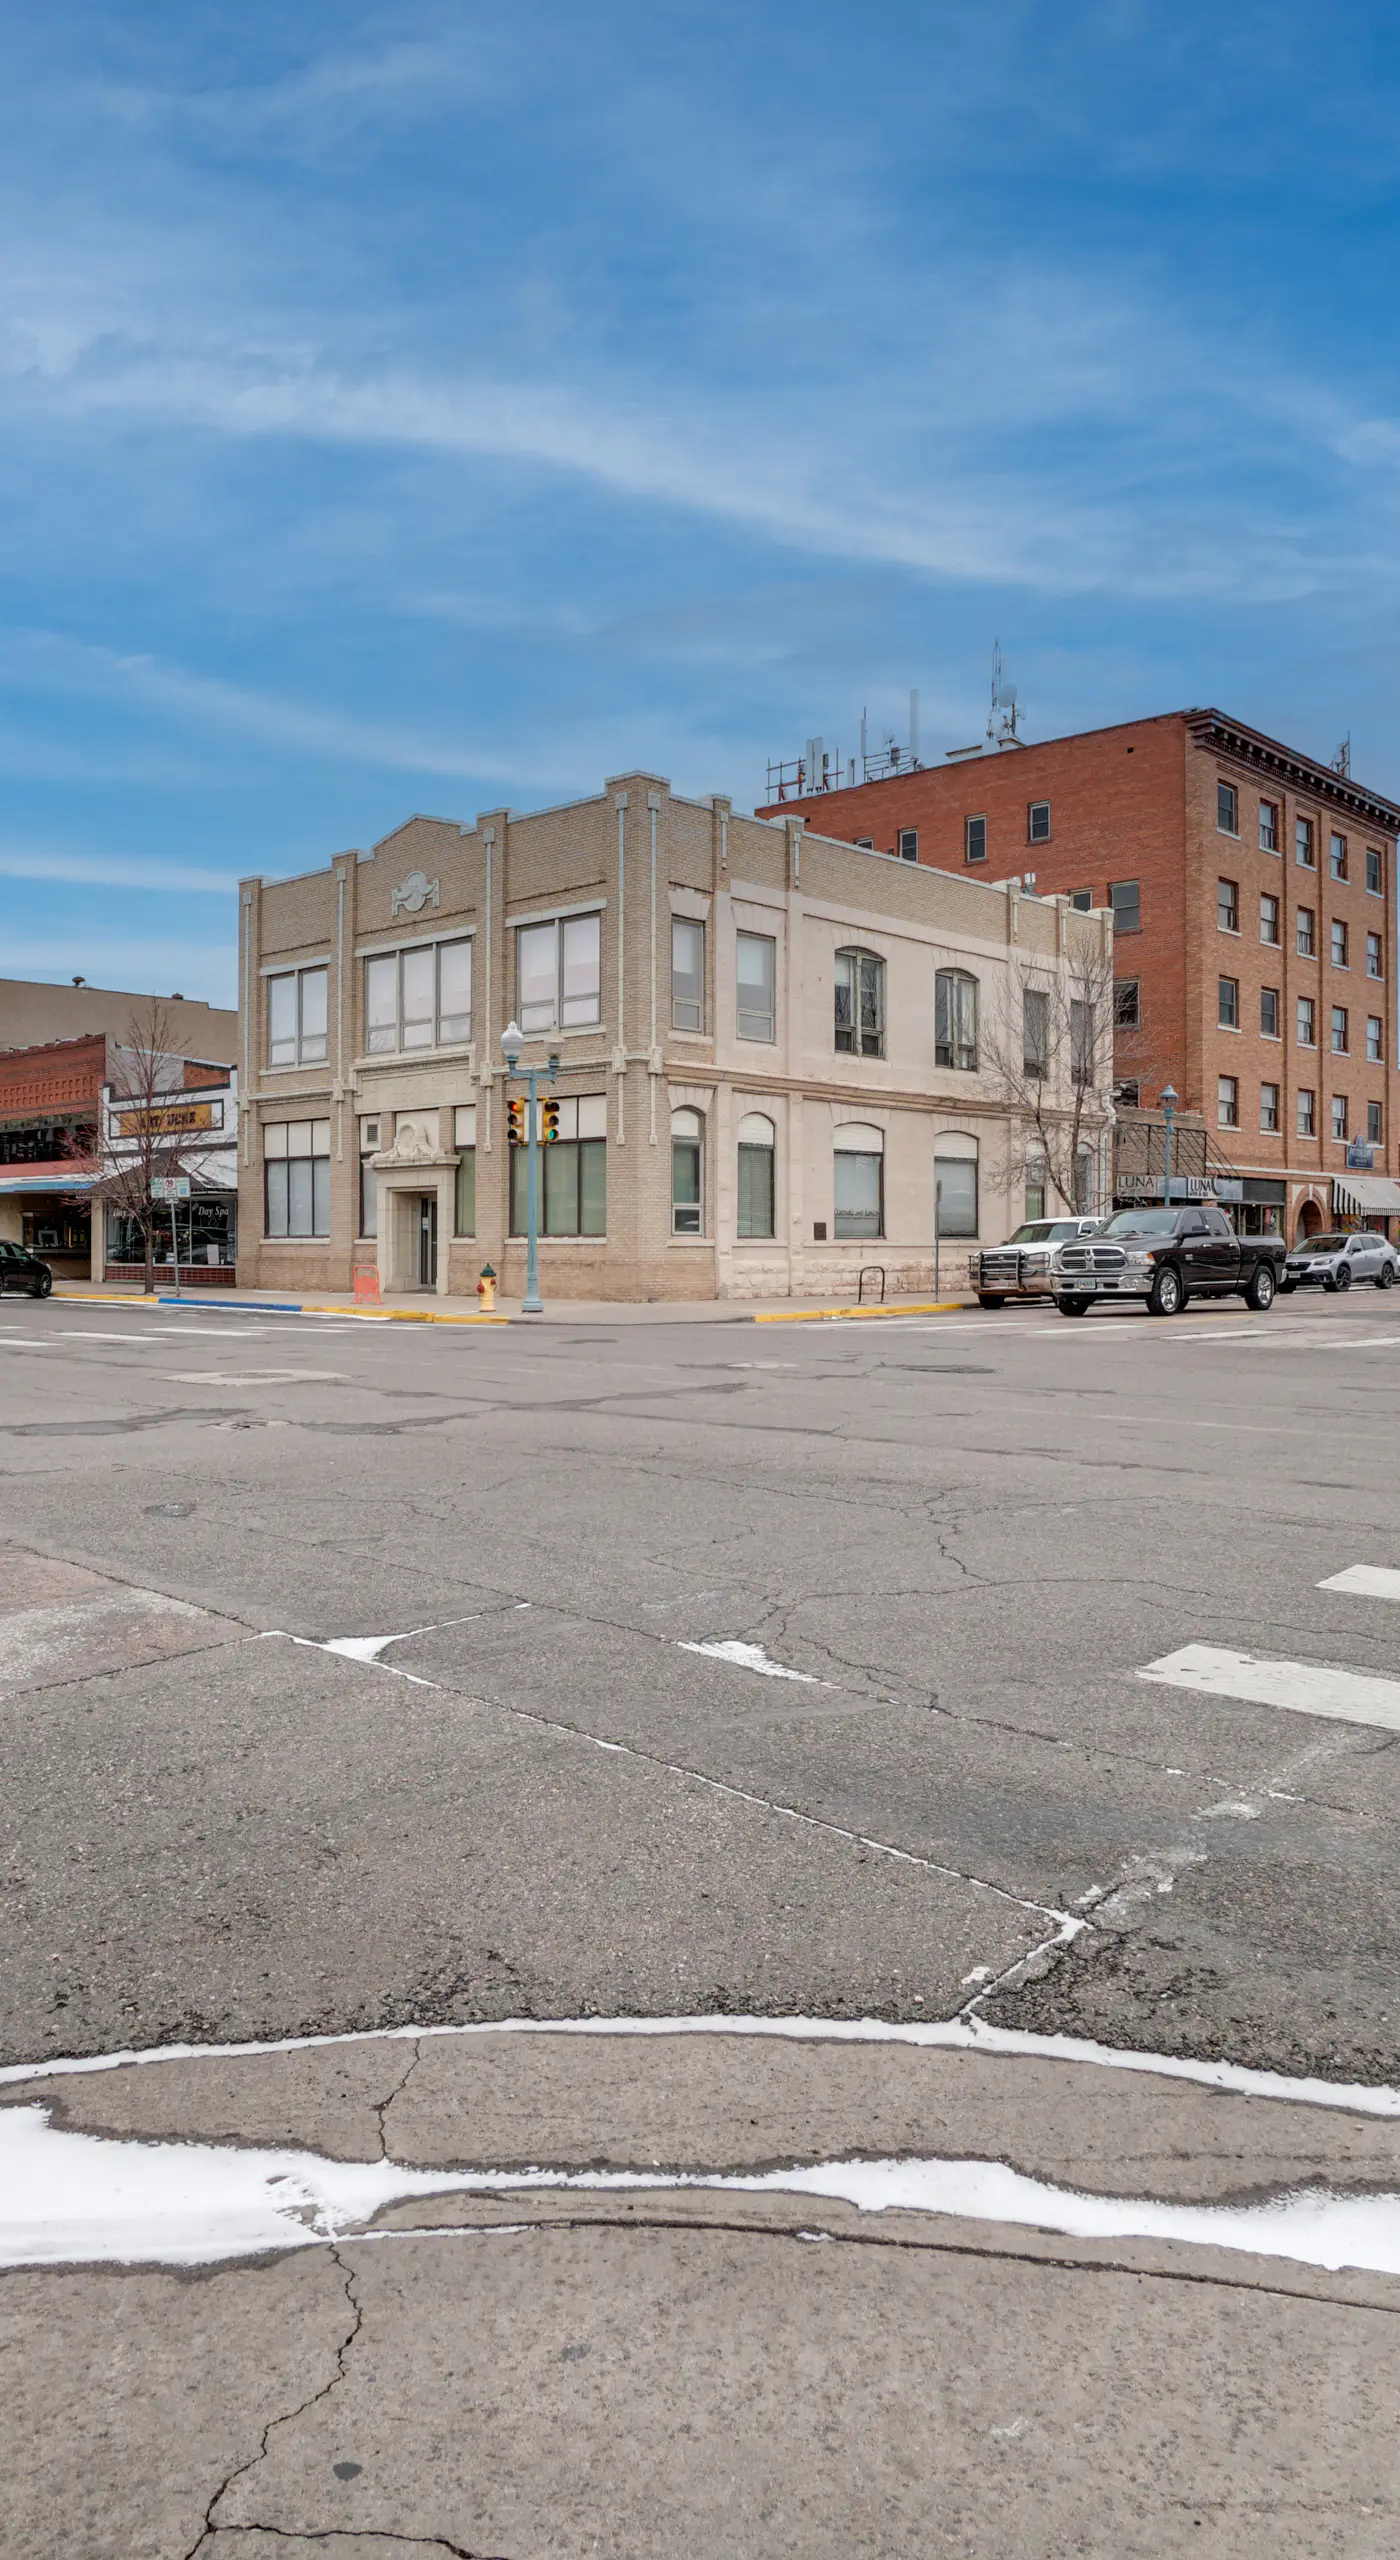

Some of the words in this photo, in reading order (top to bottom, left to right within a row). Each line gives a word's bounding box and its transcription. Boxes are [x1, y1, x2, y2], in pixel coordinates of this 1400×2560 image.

[1118, 1176, 1154, 1188] LUNA
[1190, 1178, 1211, 1192] LUNA
[198, 1206, 214, 1218] Day
[214, 1205, 229, 1218] Spa
